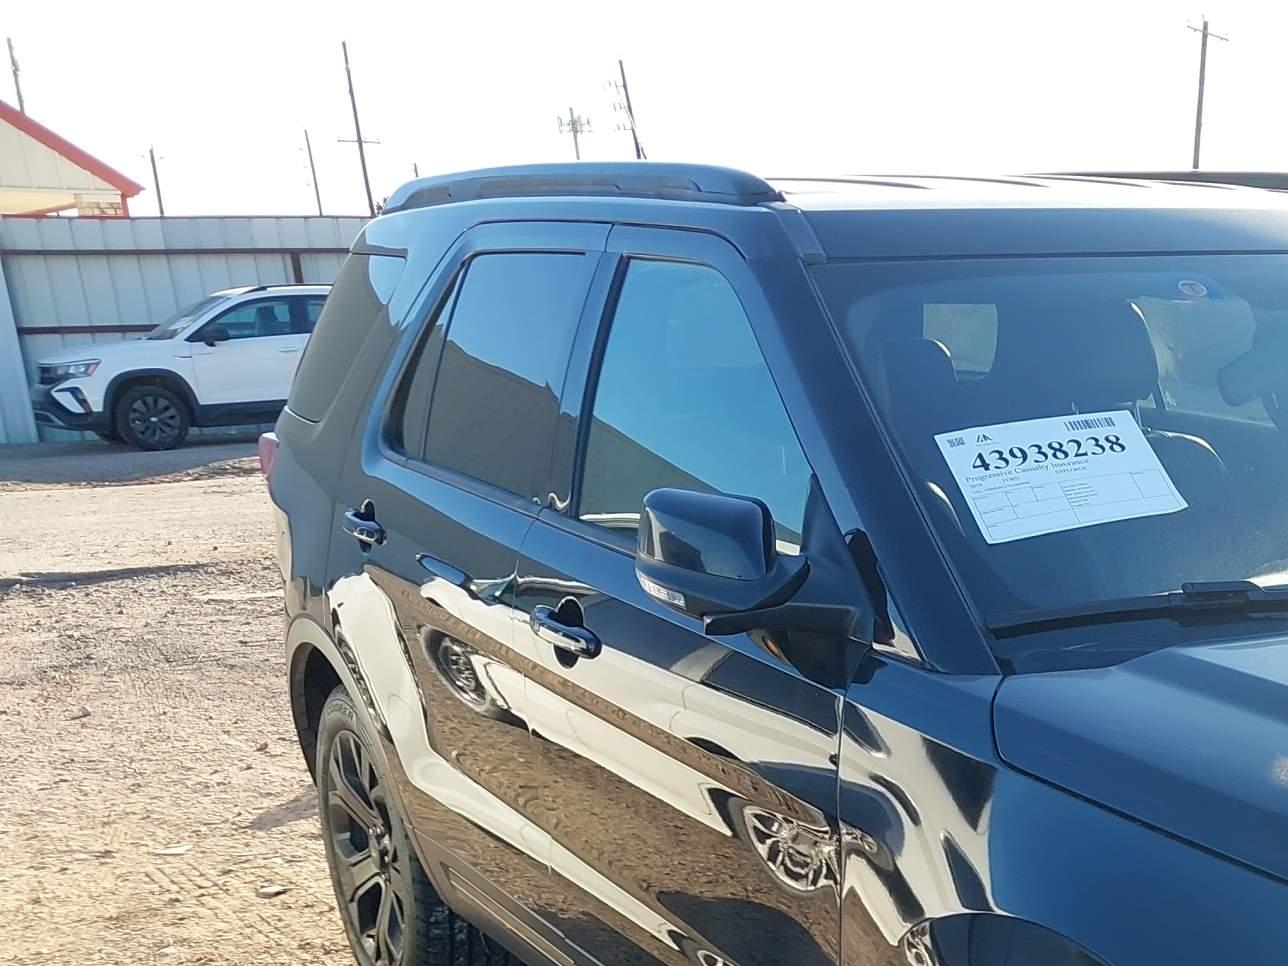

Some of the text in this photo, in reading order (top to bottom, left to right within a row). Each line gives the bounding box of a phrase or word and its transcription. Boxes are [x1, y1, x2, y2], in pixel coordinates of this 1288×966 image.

[972, 434, 1126, 472] 43938238
[965, 459, 1089, 483] Progressive Casualty Insurance
